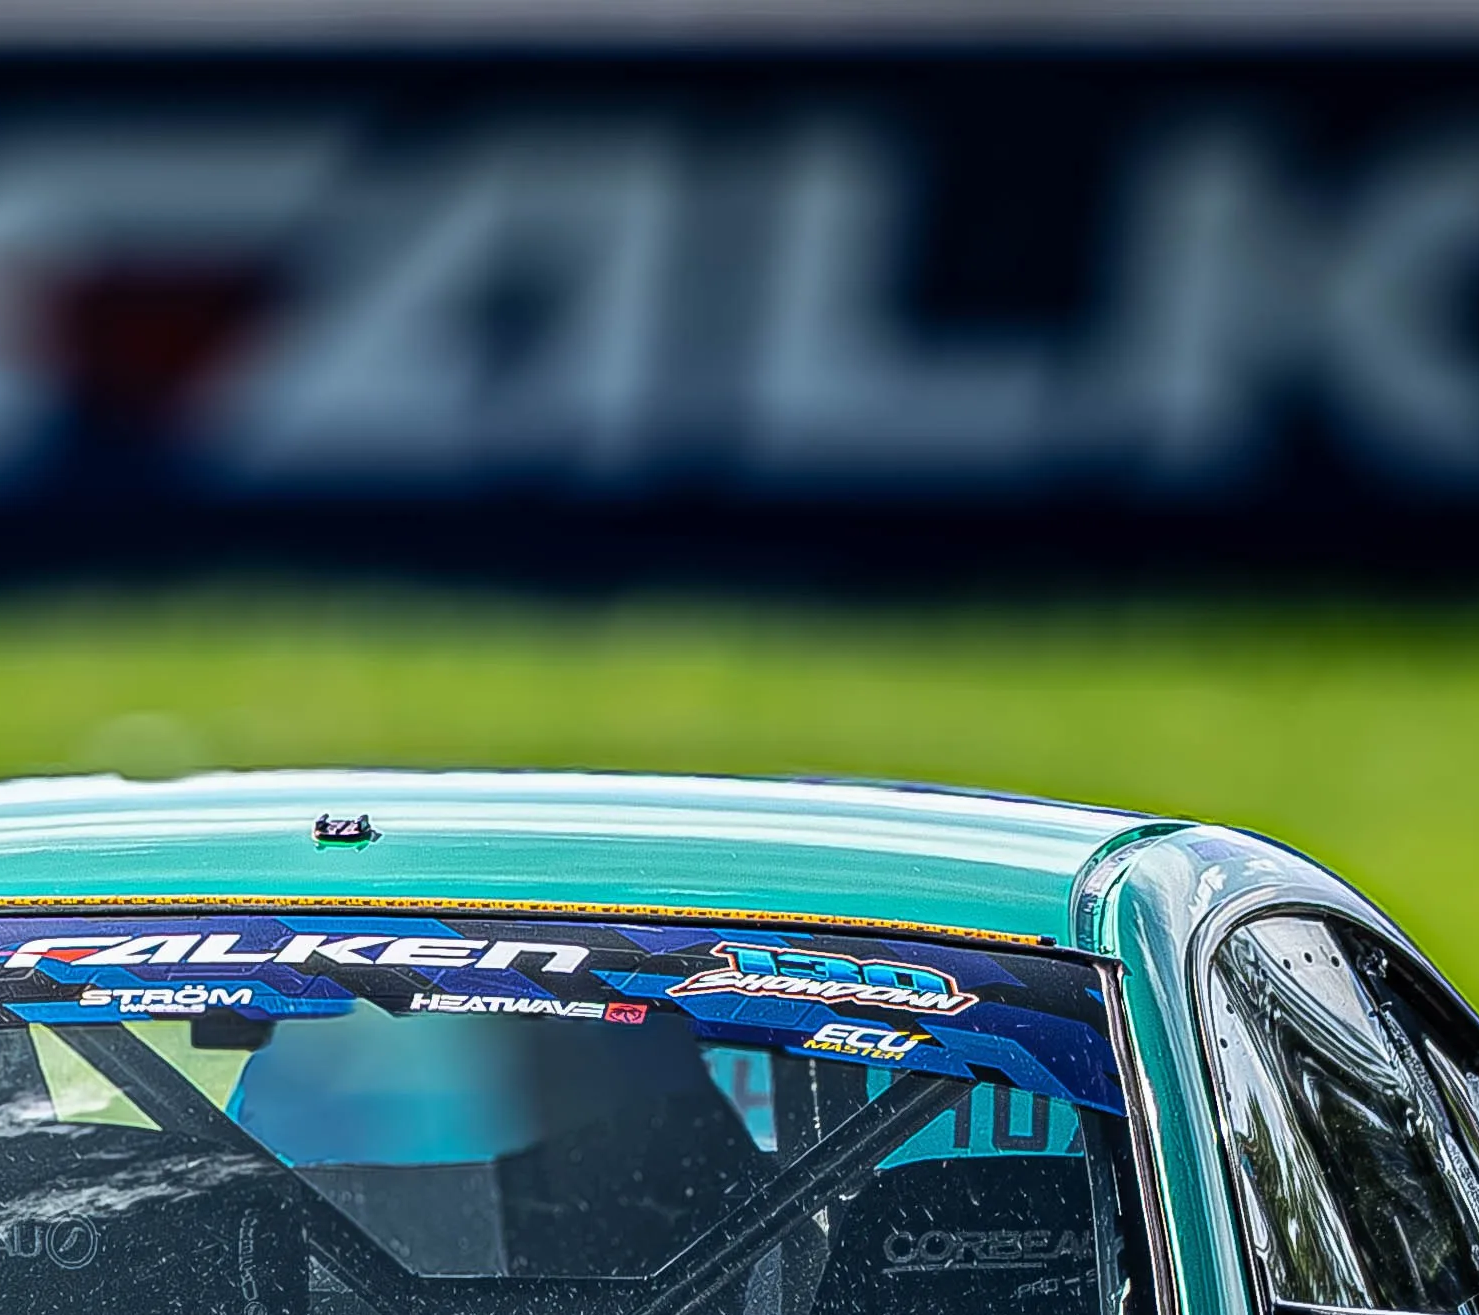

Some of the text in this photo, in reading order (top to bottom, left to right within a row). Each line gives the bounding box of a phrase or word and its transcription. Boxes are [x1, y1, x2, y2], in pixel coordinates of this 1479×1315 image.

[4, 933, 590, 974] FALKEN
[725, 946, 947, 994] 130
[79, 984, 253, 1006] STRÖM
[690, 970, 965, 1010] SHOWDOWN
[410, 993, 606, 1019] HEATWAVE
[803, 1039, 906, 1061] MASTER
[812, 1023, 930, 1052] ECU
